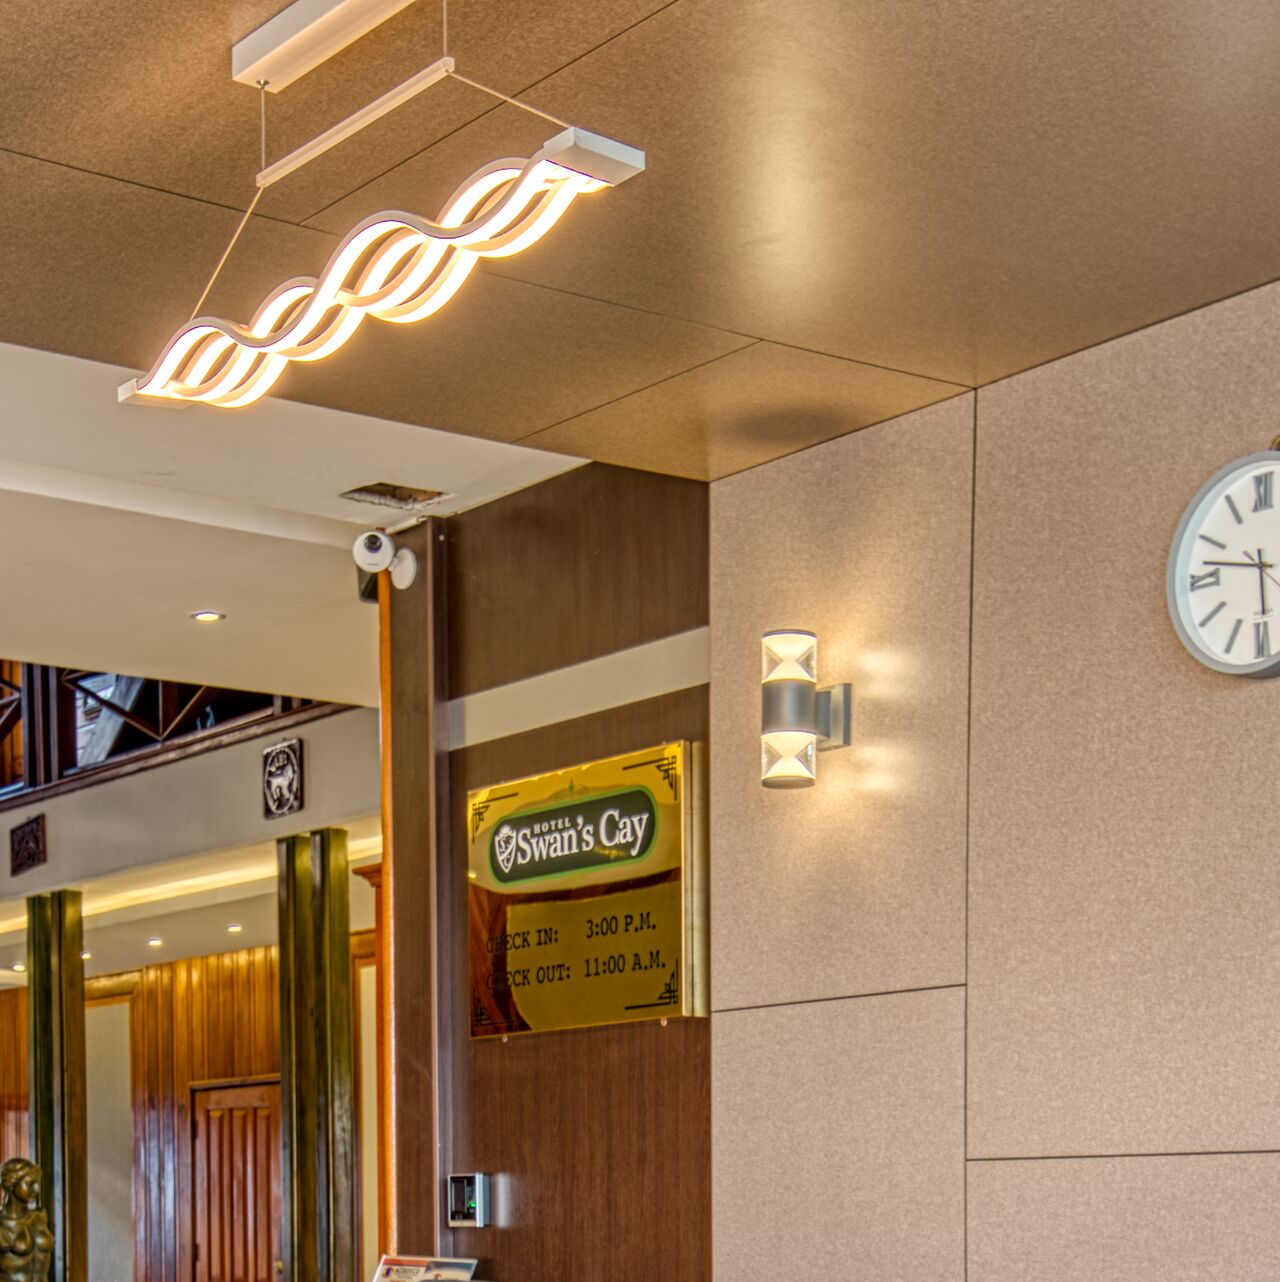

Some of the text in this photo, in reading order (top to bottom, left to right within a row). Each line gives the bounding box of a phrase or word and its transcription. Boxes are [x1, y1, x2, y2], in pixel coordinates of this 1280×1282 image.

[516, 815, 595, 865] Swan's
[599, 808, 649, 857] Cay
[533, 816, 571, 835] HOTEL
[486, 911, 657, 953] CHECK IN: 3:00 P.M.
[486, 950, 666, 990] CECK OUT: 11:00 A.M.
